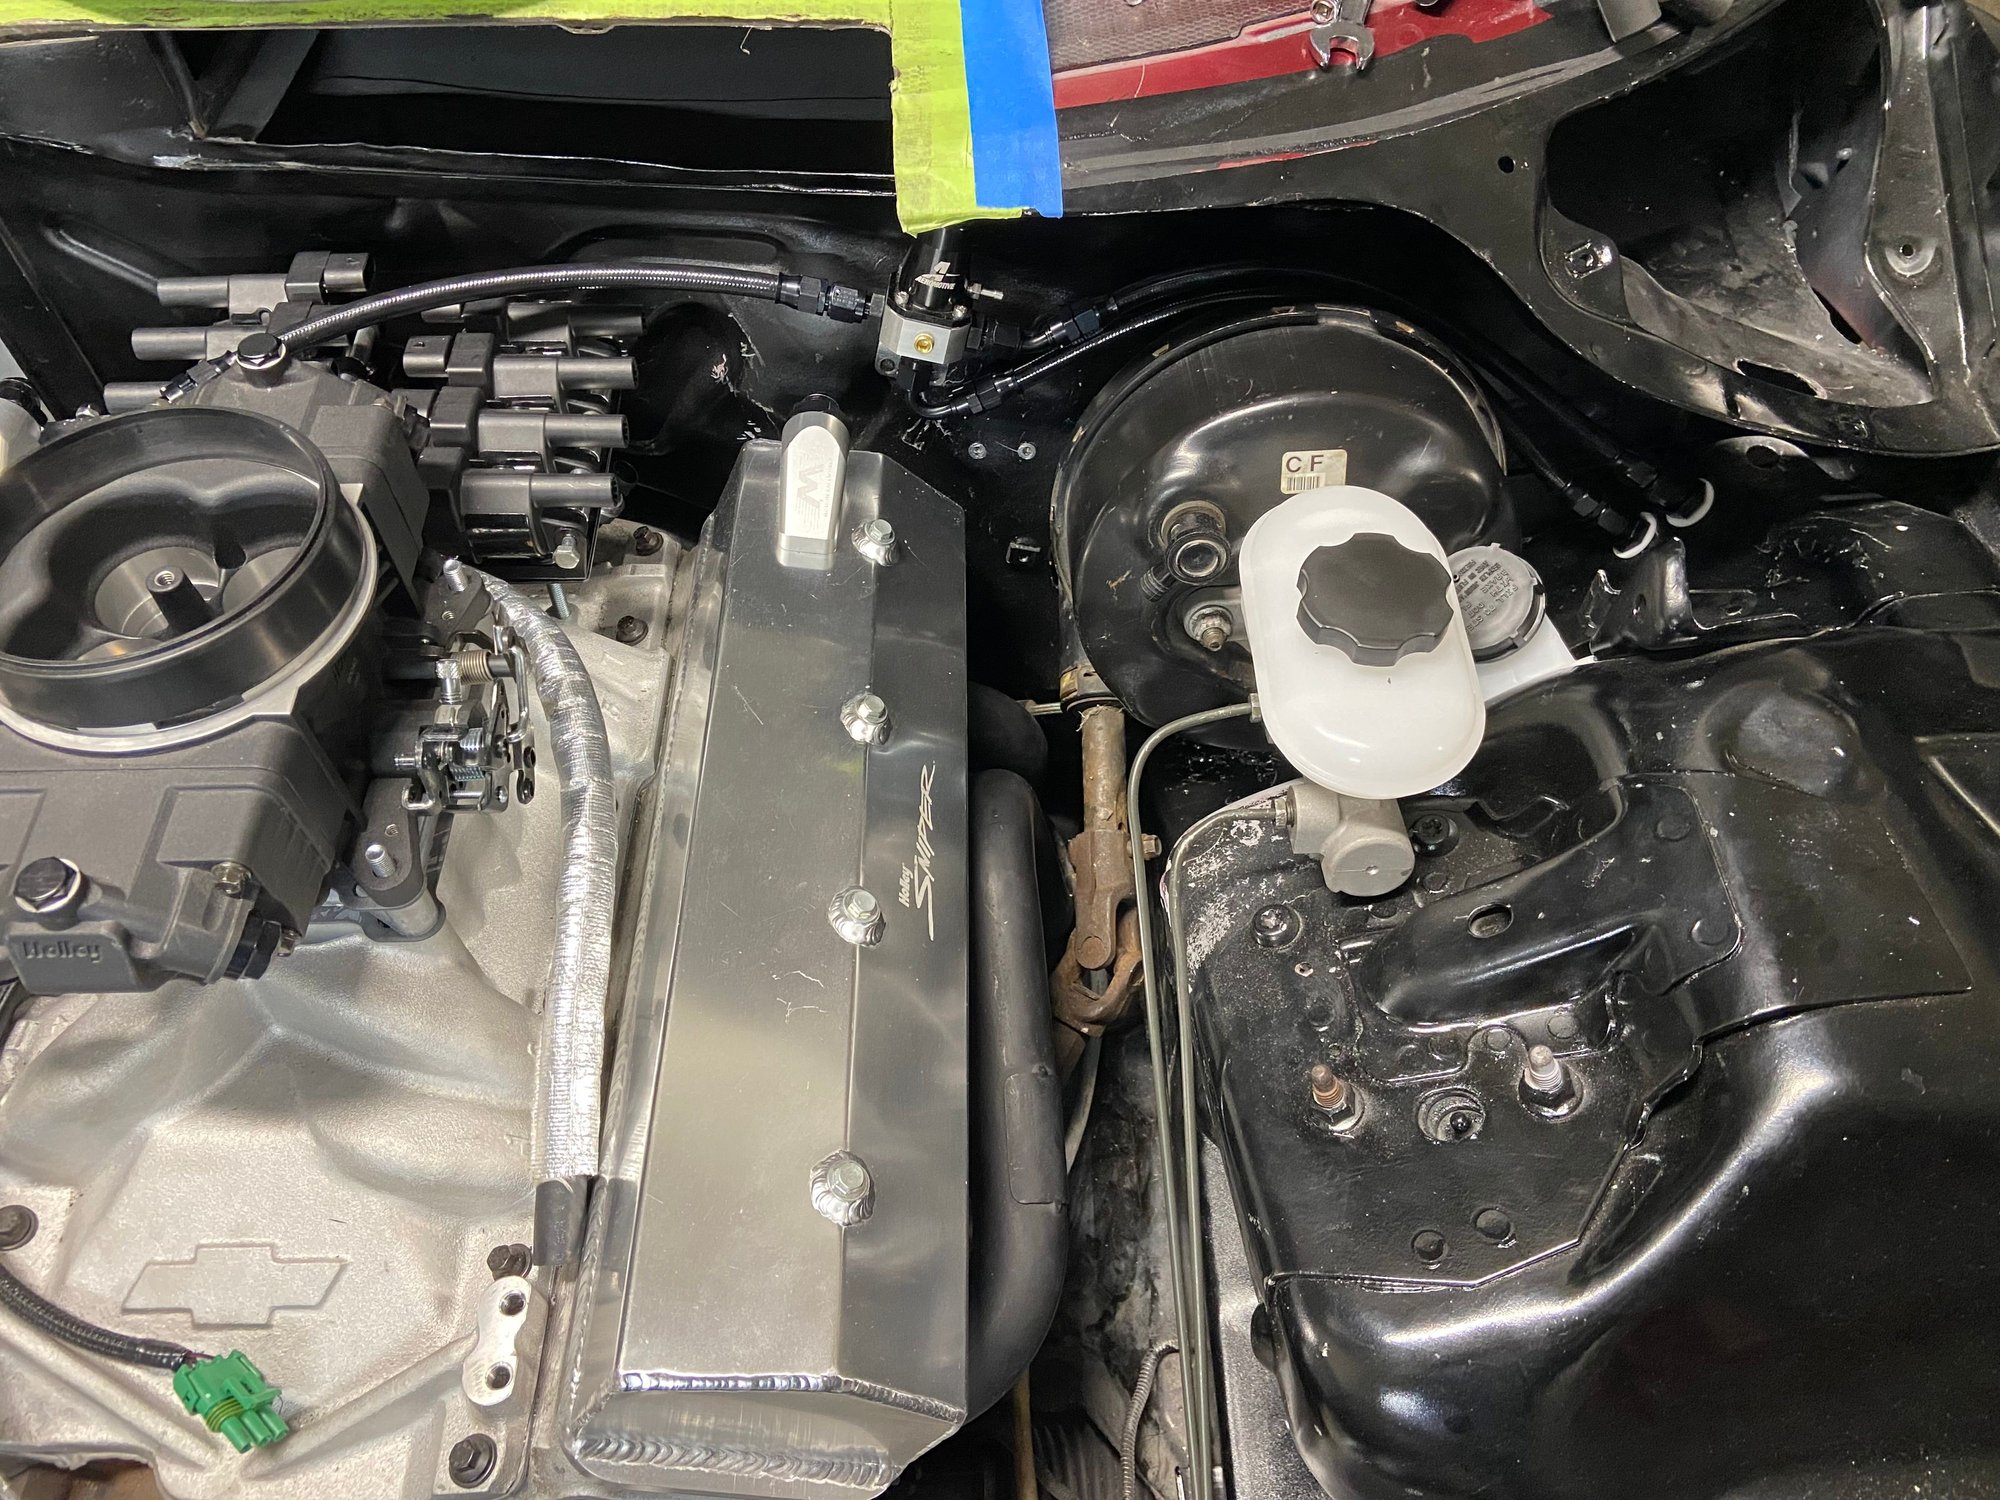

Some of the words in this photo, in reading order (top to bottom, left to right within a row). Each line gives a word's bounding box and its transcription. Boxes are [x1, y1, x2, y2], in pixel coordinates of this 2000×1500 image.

[914, 275, 956, 290] AEROMOTIVE
[1480, 569, 1509, 594] BRAKE
[914, 760, 936, 942] SNIPER
[899, 864, 914, 908] Holley
[22, 940, 102, 964] Holley
